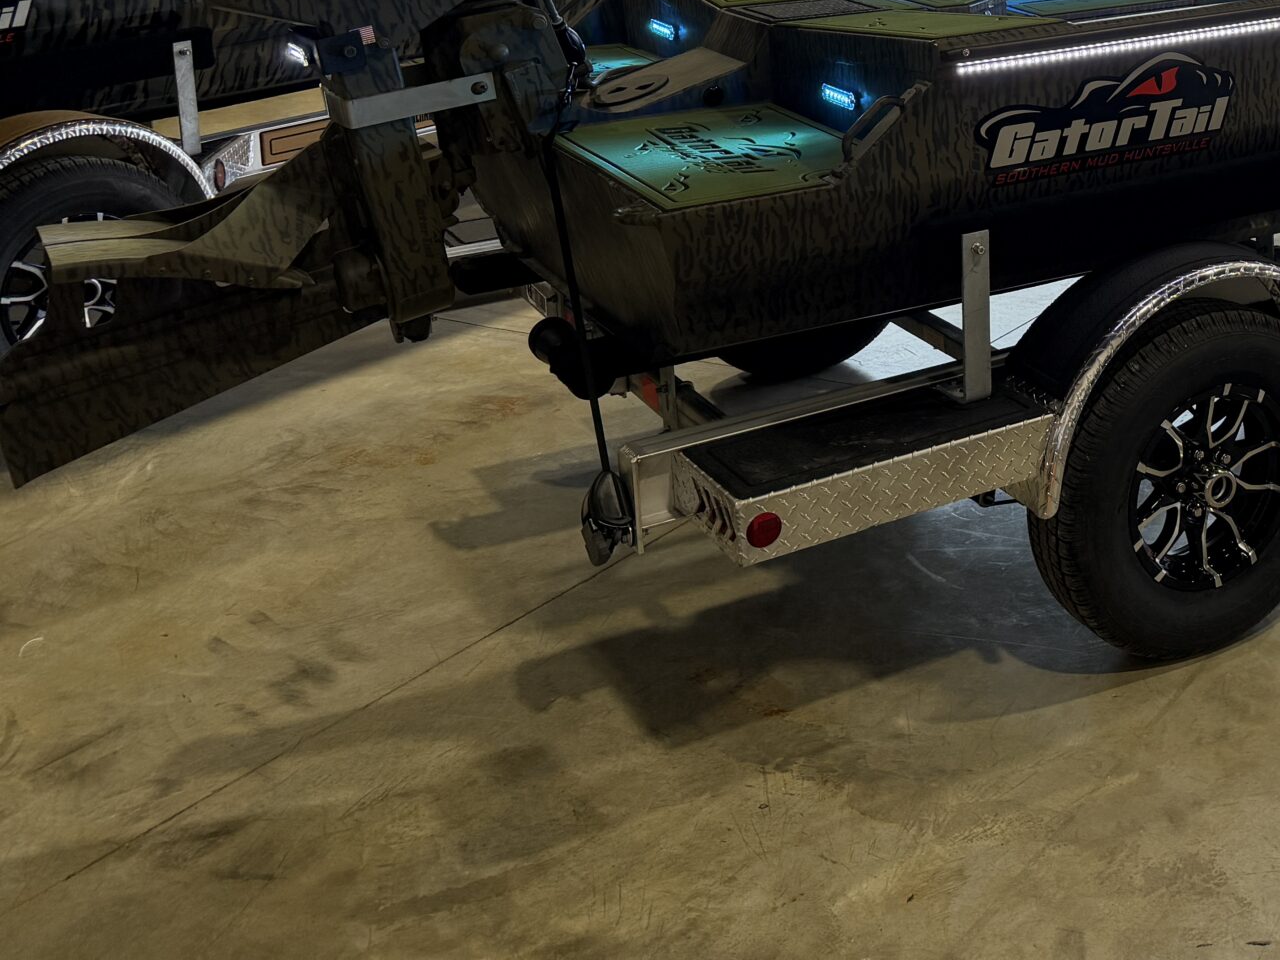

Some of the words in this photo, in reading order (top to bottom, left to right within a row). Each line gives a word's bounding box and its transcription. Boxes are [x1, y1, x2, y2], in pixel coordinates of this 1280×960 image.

[989, 96, 1230, 169] GatorTail
[995, 161, 1081, 185] SOUTHERN
[1087, 152, 1120, 167] MUD
[1123, 138, 1210, 161] HUNTSVILLE
